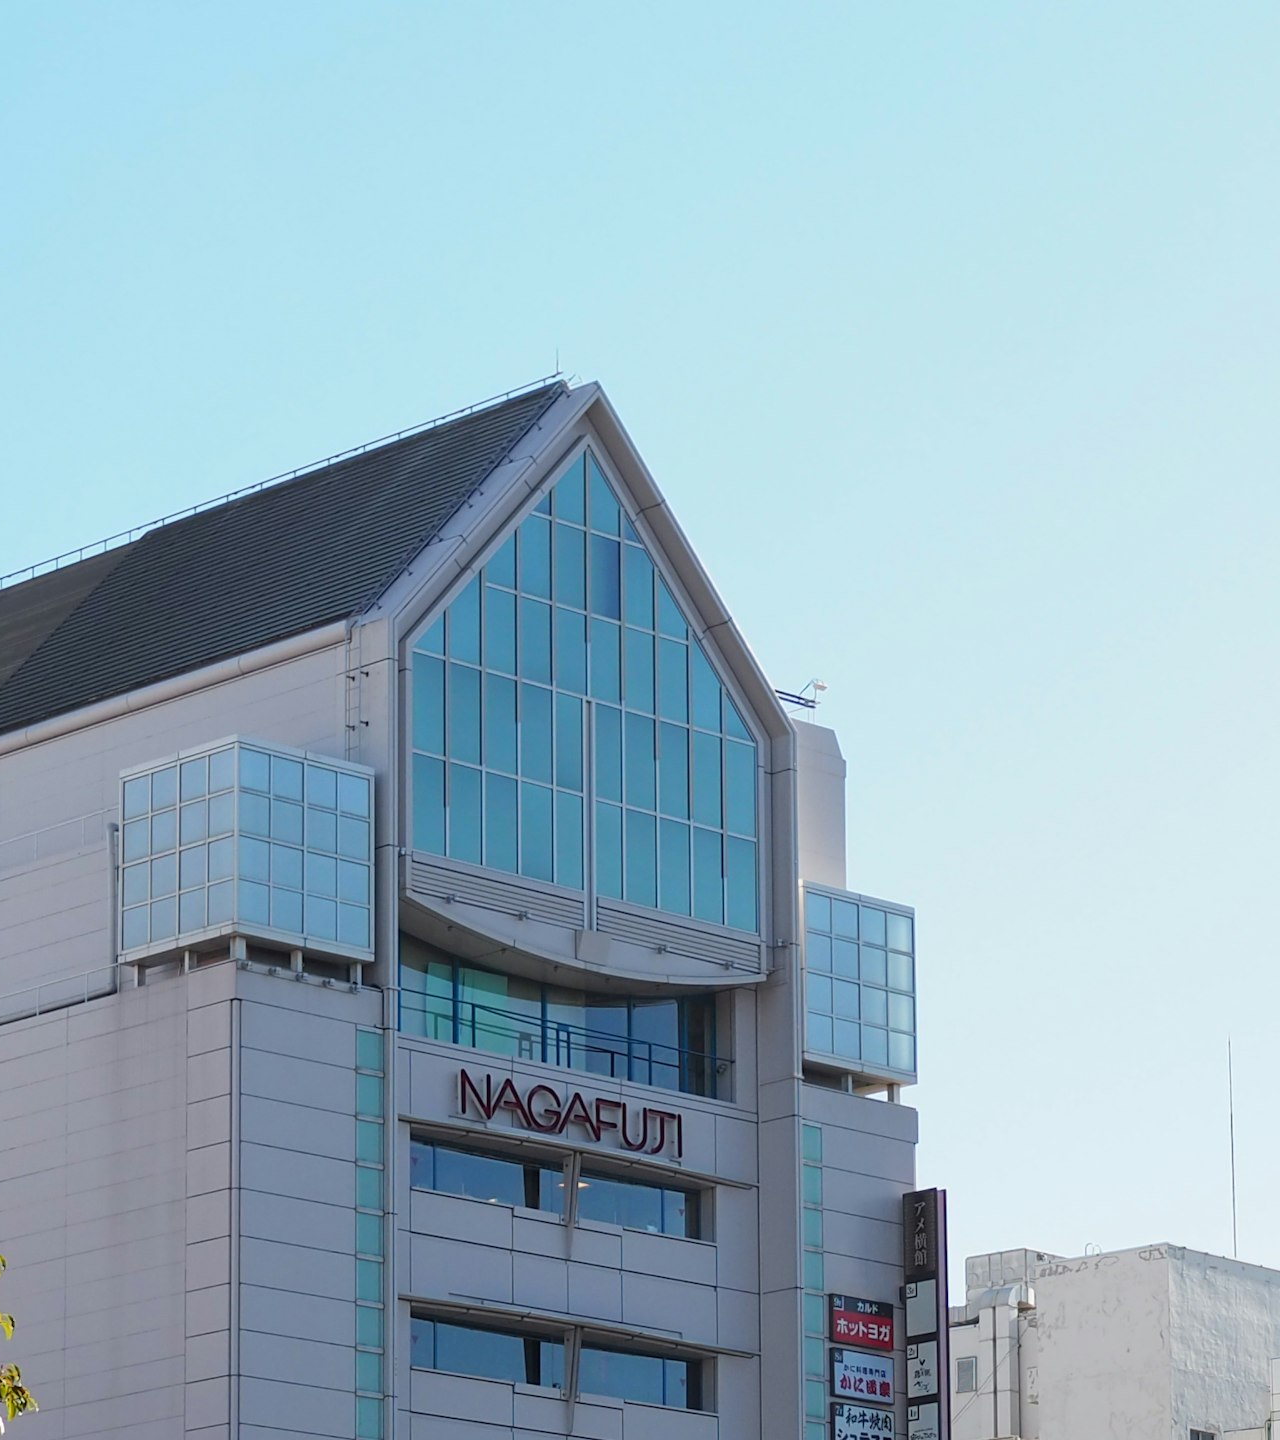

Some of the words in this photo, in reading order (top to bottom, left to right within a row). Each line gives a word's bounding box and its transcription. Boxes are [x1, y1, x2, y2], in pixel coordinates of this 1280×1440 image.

[458, 1067, 684, 1160] NAGAFUJI
[914, 1201, 928, 1266] アメ横館
[857, 1301, 879, 1314] カルド
[837, 1318, 891, 1342] ホットヨガ
[840, 1374, 892, 1398] かに道楽
[846, 1408, 892, 1432] 和牛焼肉
